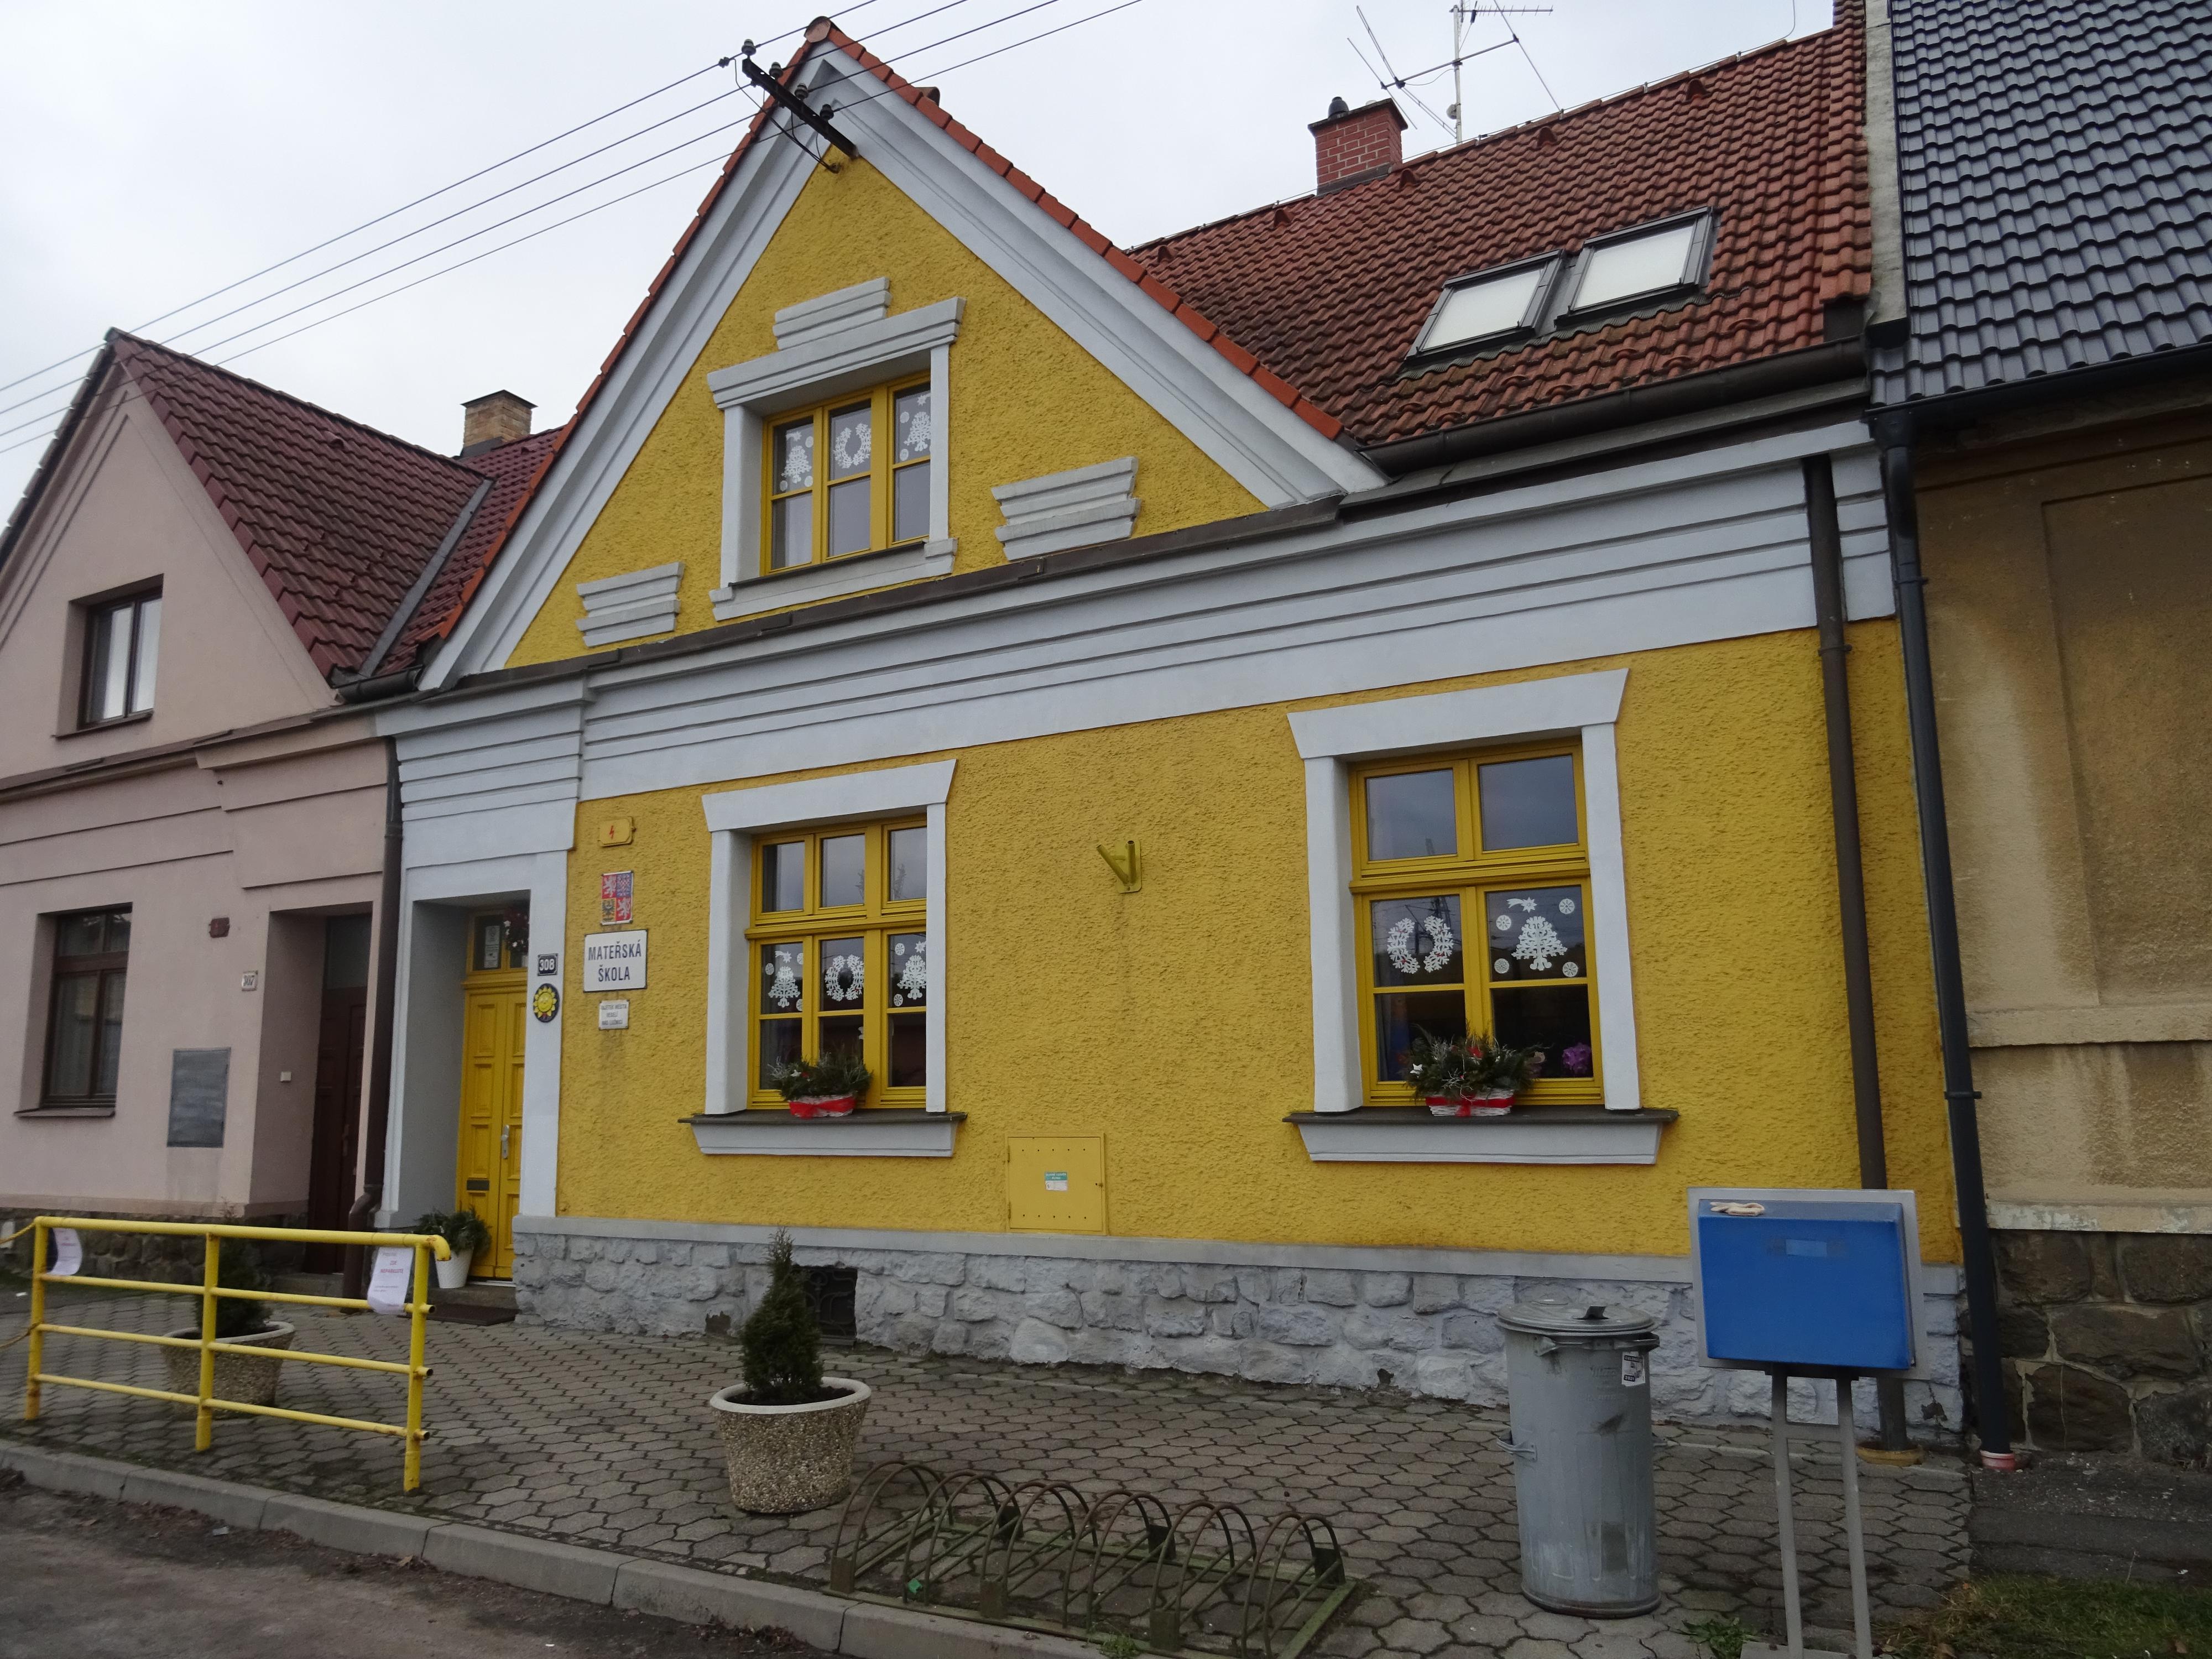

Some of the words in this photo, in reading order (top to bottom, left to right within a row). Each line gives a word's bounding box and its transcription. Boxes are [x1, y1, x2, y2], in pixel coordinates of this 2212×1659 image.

[588, 939, 641, 961] MATEŘSKÁ
[539, 958, 555, 971] 308
[598, 964, 630, 982] ŠKOLA
